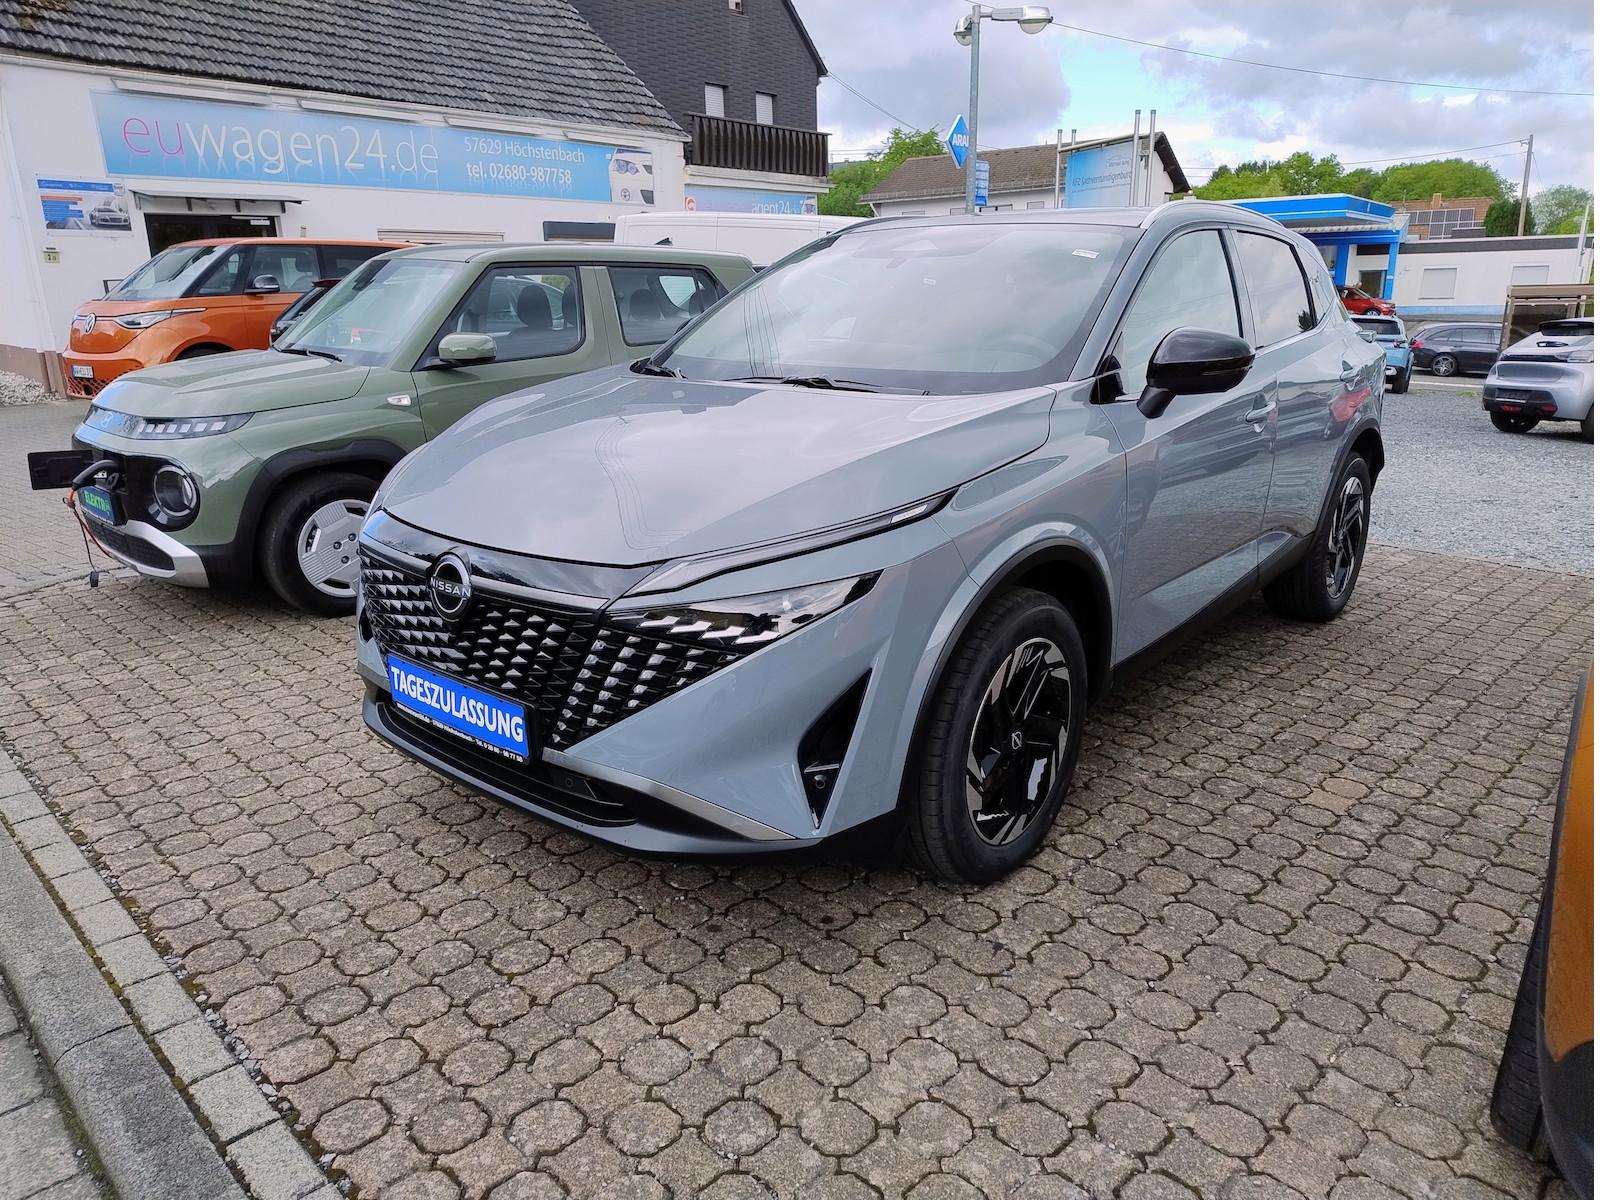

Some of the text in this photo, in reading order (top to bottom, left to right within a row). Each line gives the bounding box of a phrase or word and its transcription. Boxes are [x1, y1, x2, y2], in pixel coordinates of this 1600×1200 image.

[122, 117, 439, 174] euwagen24.de
[464, 136, 585, 163] 57629 Höchstenbach
[466, 162, 572, 185] tel. 02680-987758
[430, 577, 471, 598] NISSAN
[391, 666, 524, 742] TAGESZULASSUNG
